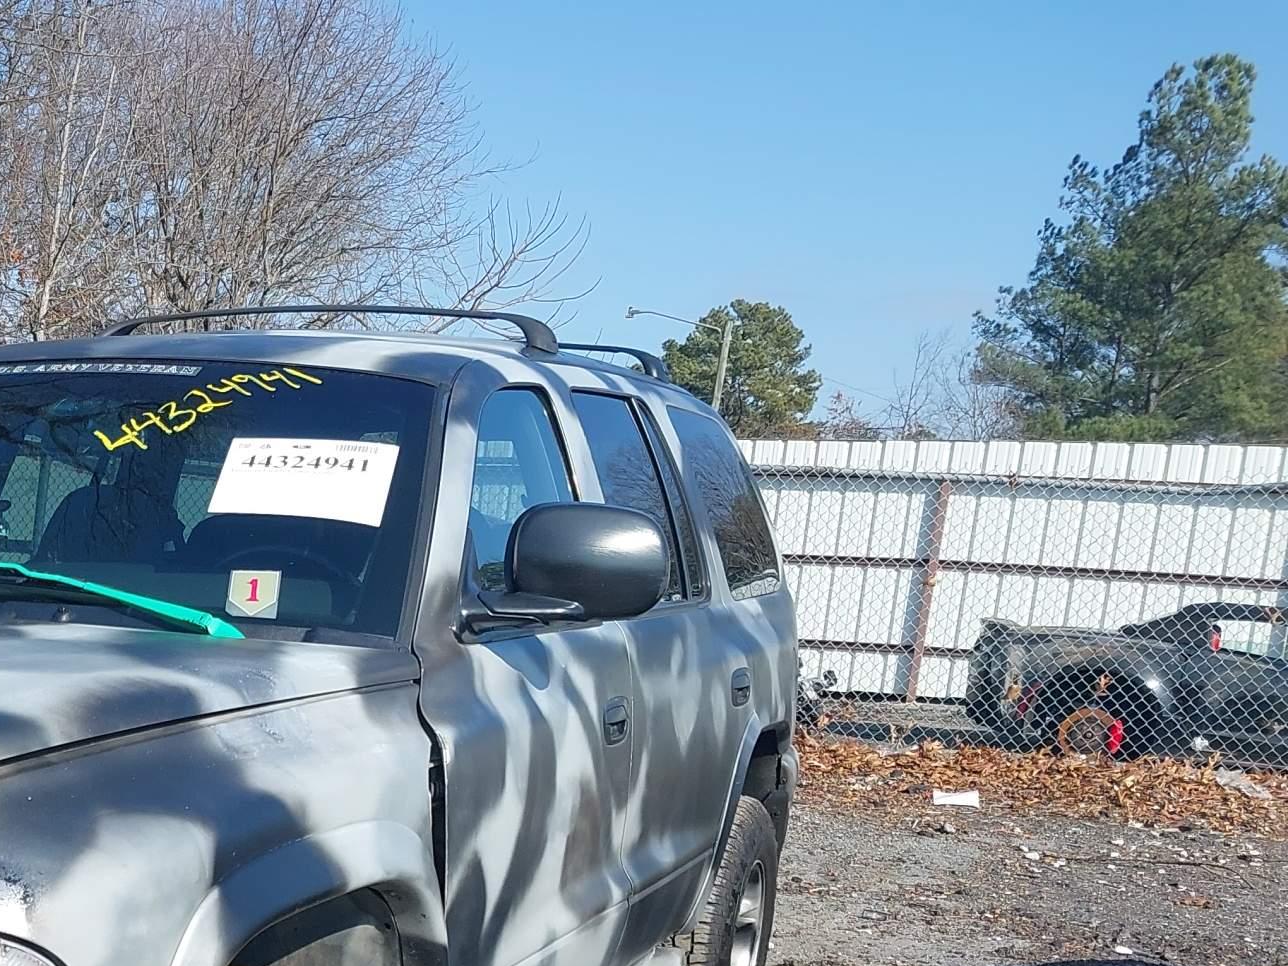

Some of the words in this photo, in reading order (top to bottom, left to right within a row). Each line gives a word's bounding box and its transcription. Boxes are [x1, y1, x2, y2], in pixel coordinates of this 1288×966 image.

[33, 364, 92, 372] ARMY
[98, 363, 197, 375] VETERAN
[94, 367, 323, 451] 44324941
[241, 454, 369, 472] 44324941
[245, 578, 259, 602] 1
